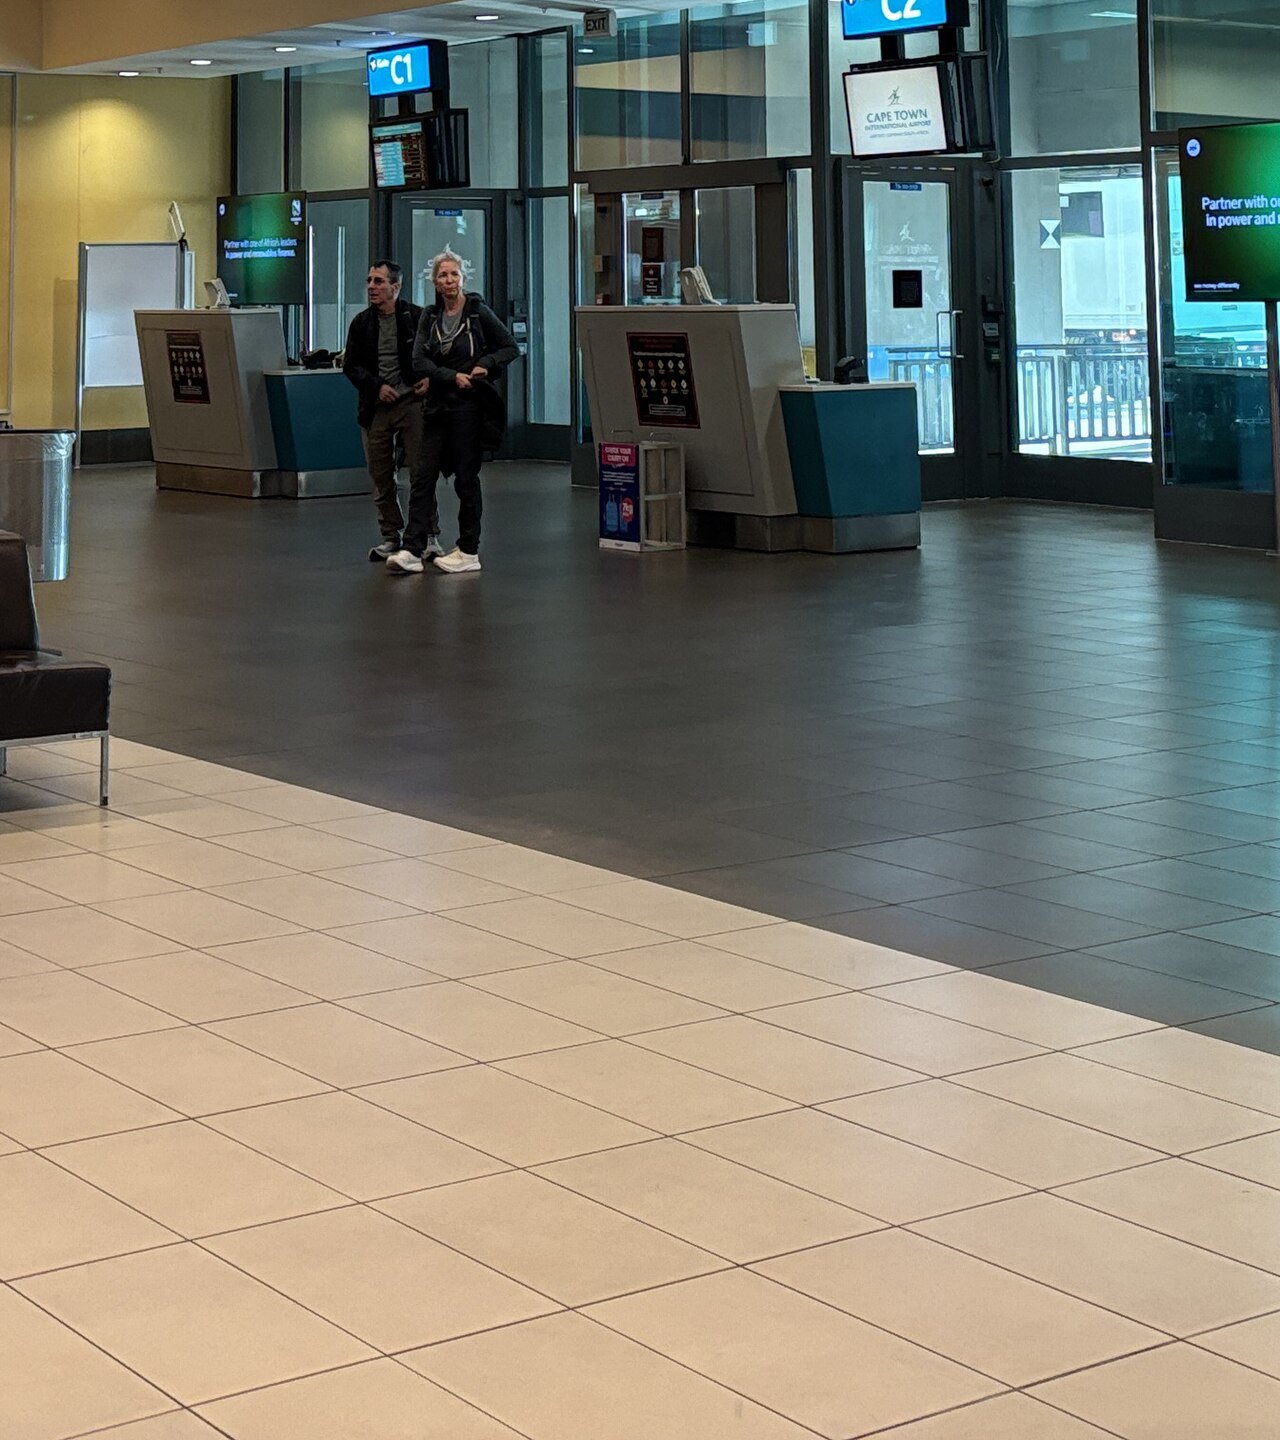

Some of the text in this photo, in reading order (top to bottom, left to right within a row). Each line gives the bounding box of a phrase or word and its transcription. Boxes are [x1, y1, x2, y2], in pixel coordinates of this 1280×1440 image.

[586, 17, 607, 31] EXIT
[390, 53, 413, 85] C1
[866, 108, 928, 124] CAPE TOWN
[1201, 196, 1243, 211] Partner
[1244, 194, 1269, 209] with
[1206, 213, 1217, 227] in
[1218, 214, 1253, 229] power
[1254, 212, 1276, 225] and
